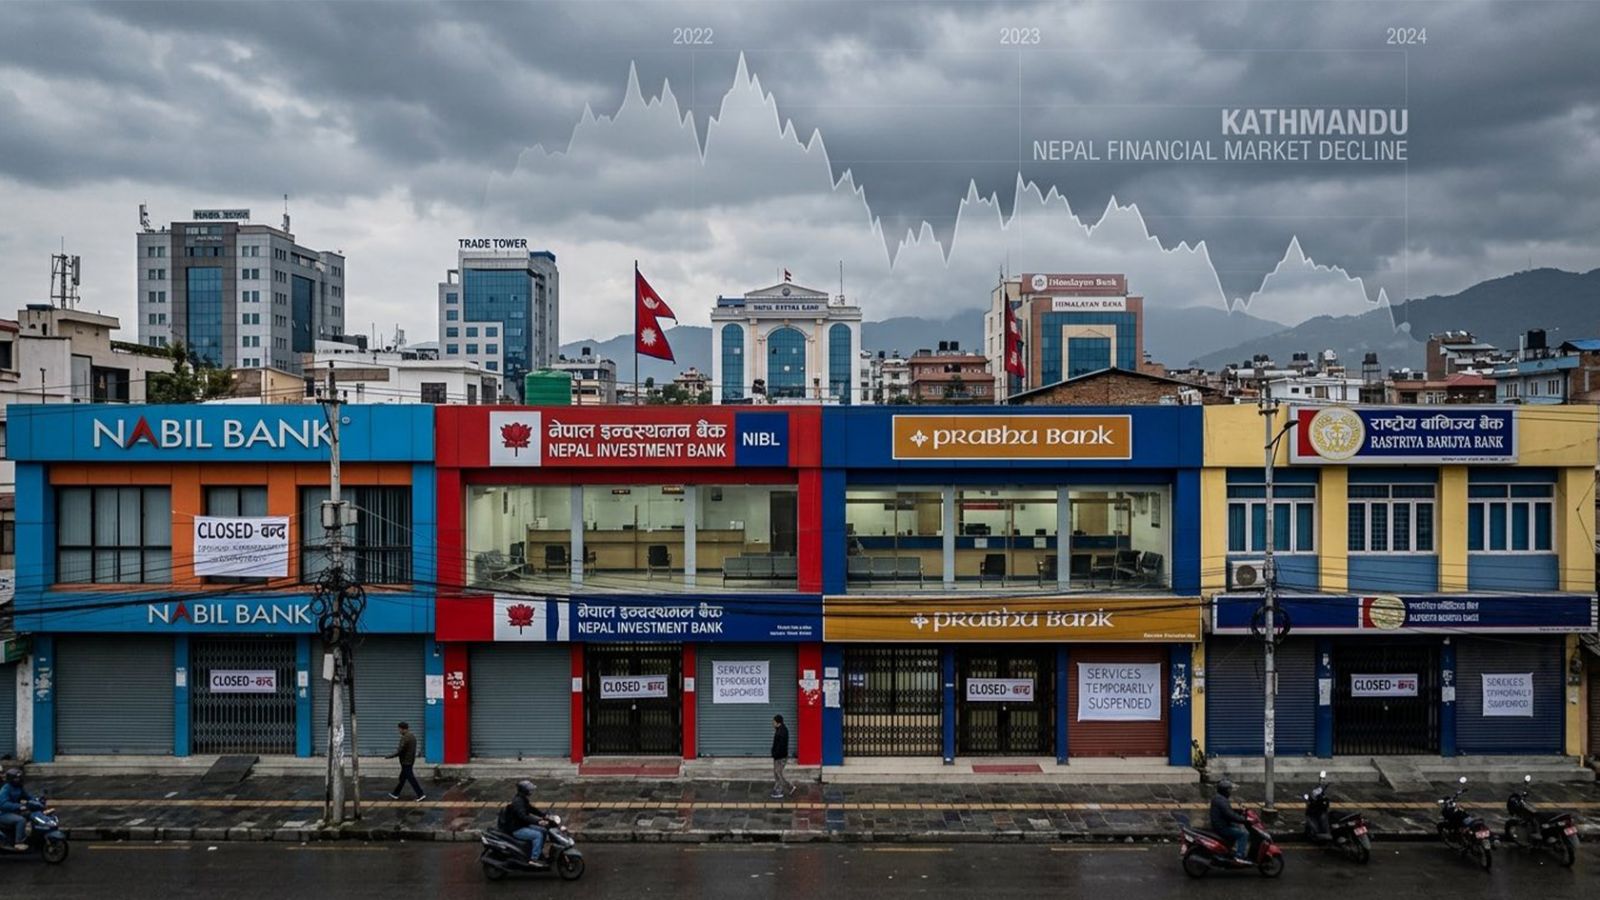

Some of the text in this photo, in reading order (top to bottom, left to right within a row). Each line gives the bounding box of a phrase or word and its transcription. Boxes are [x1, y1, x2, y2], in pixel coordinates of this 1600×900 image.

[458, 239, 527, 248] TRADE TOWER
[93, 415, 332, 448] NABIL BANK
[548, 420, 596, 439] नेपाल
[742, 432, 781, 446] NIBL
[1370, 435, 1424, 448] RASTRIYA
[549, 443, 727, 457] NEPAL INVESTMENT BANK
[148, 602, 312, 624] NABIL BANK
[577, 622, 723, 633] NEPAL INVESTMENT BANK
[717, 665, 761, 675] SERVICES
[1087, 668, 1141, 680] SERVICES
[1085, 683, 1154, 694] TEMPORARILY
[1088, 697, 1152, 710] SUSPENDED
